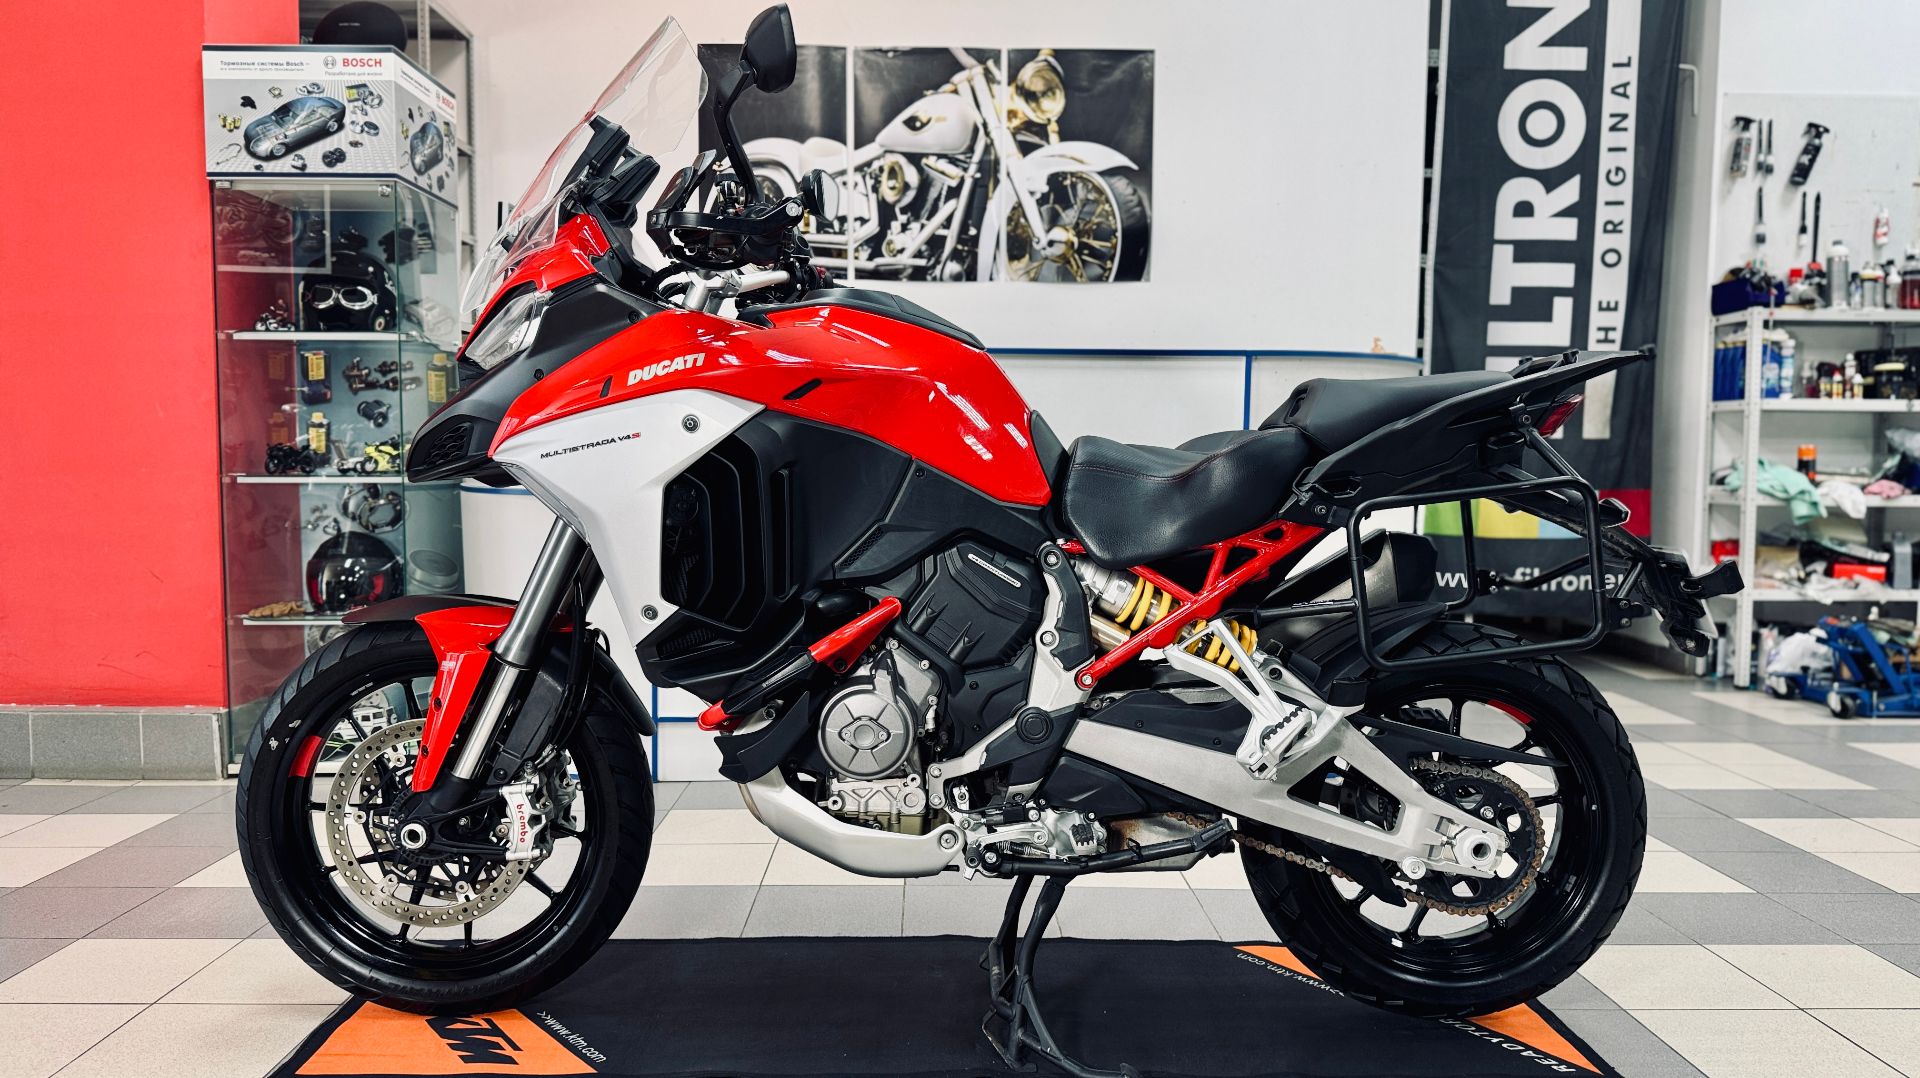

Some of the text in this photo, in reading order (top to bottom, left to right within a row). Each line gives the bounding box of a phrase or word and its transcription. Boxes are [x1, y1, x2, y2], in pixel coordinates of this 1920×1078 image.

[342, 58, 382, 68] BOSCH
[1595, 56, 1632, 344] HE ORIGINAL
[627, 353, 706, 386] DUCATI
[540, 437, 617, 459] MULTISTRADA
[516, 803, 529, 843] brembo
[424, 1016, 524, 1066] KTM
